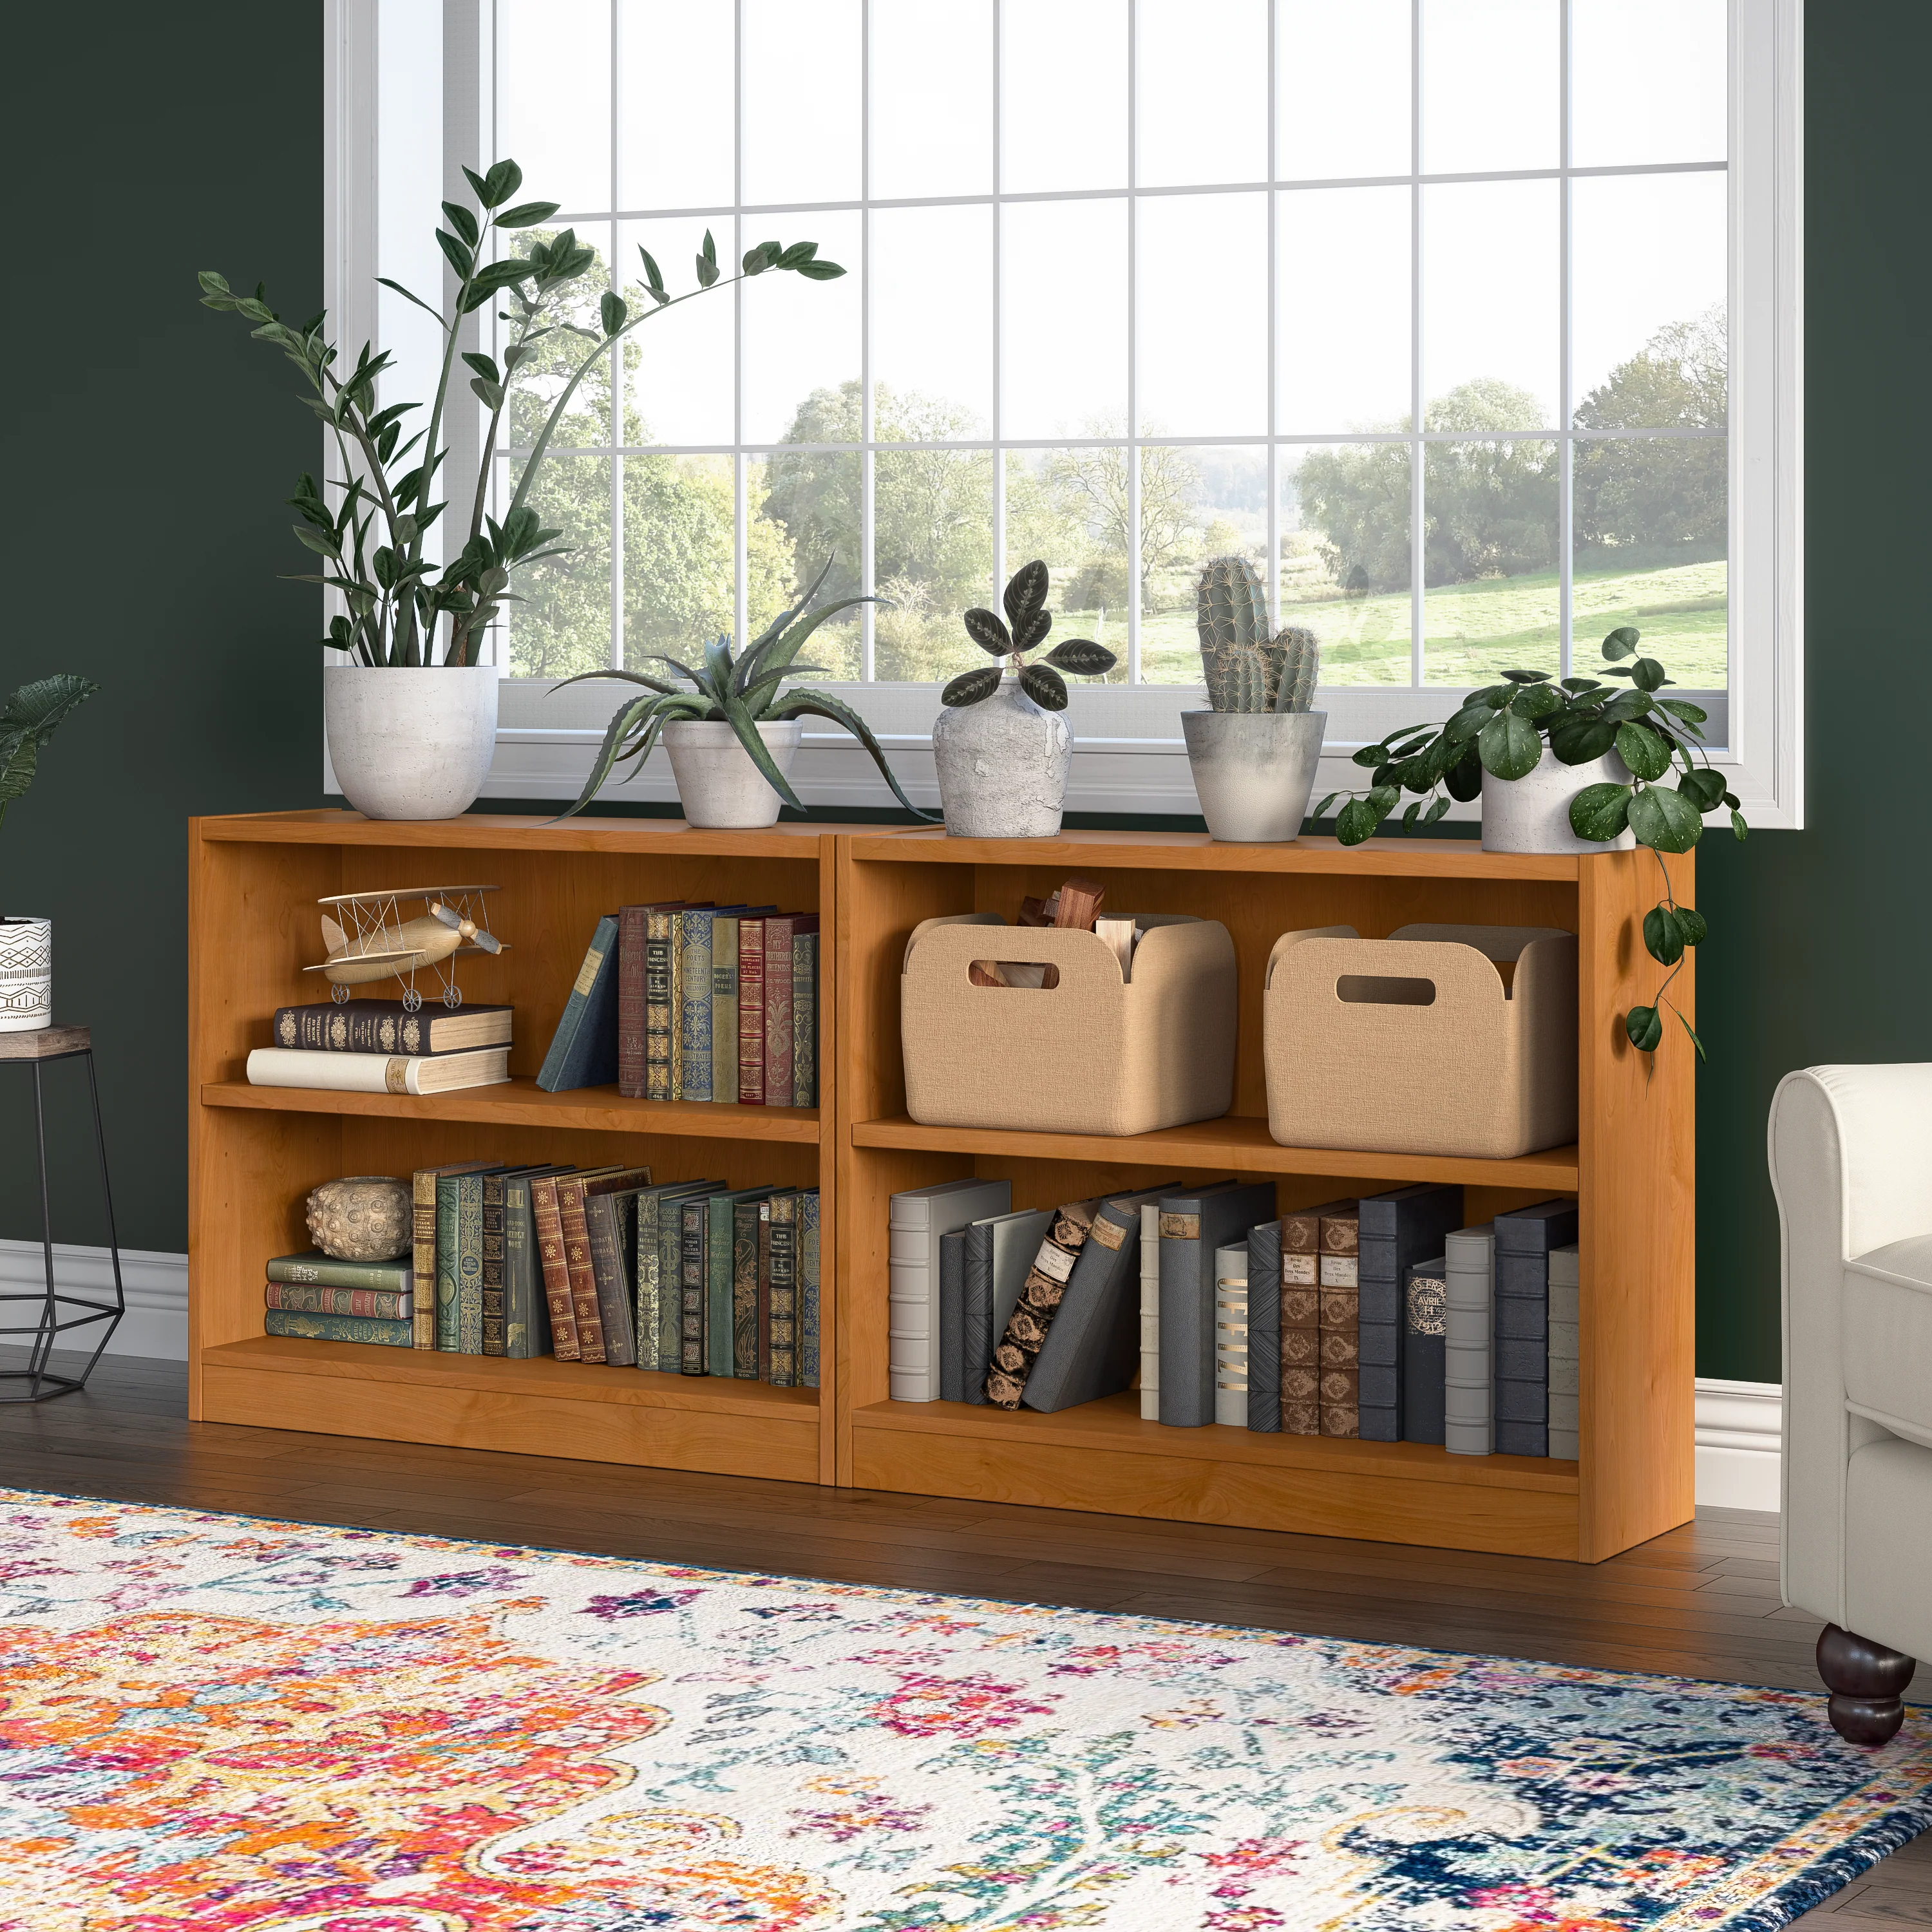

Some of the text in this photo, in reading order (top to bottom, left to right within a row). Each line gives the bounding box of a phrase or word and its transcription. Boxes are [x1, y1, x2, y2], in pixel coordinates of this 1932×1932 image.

[773, 940, 782, 949] MY
[1050, 1249, 1061, 1258] Revue
[1040, 1255, 1064, 1272] Deux Mondes
[312, 1270, 318, 1280] PS
[1417, 1296, 1442, 1306] AVRIL
[1423, 1305, 1435, 1316] 14
